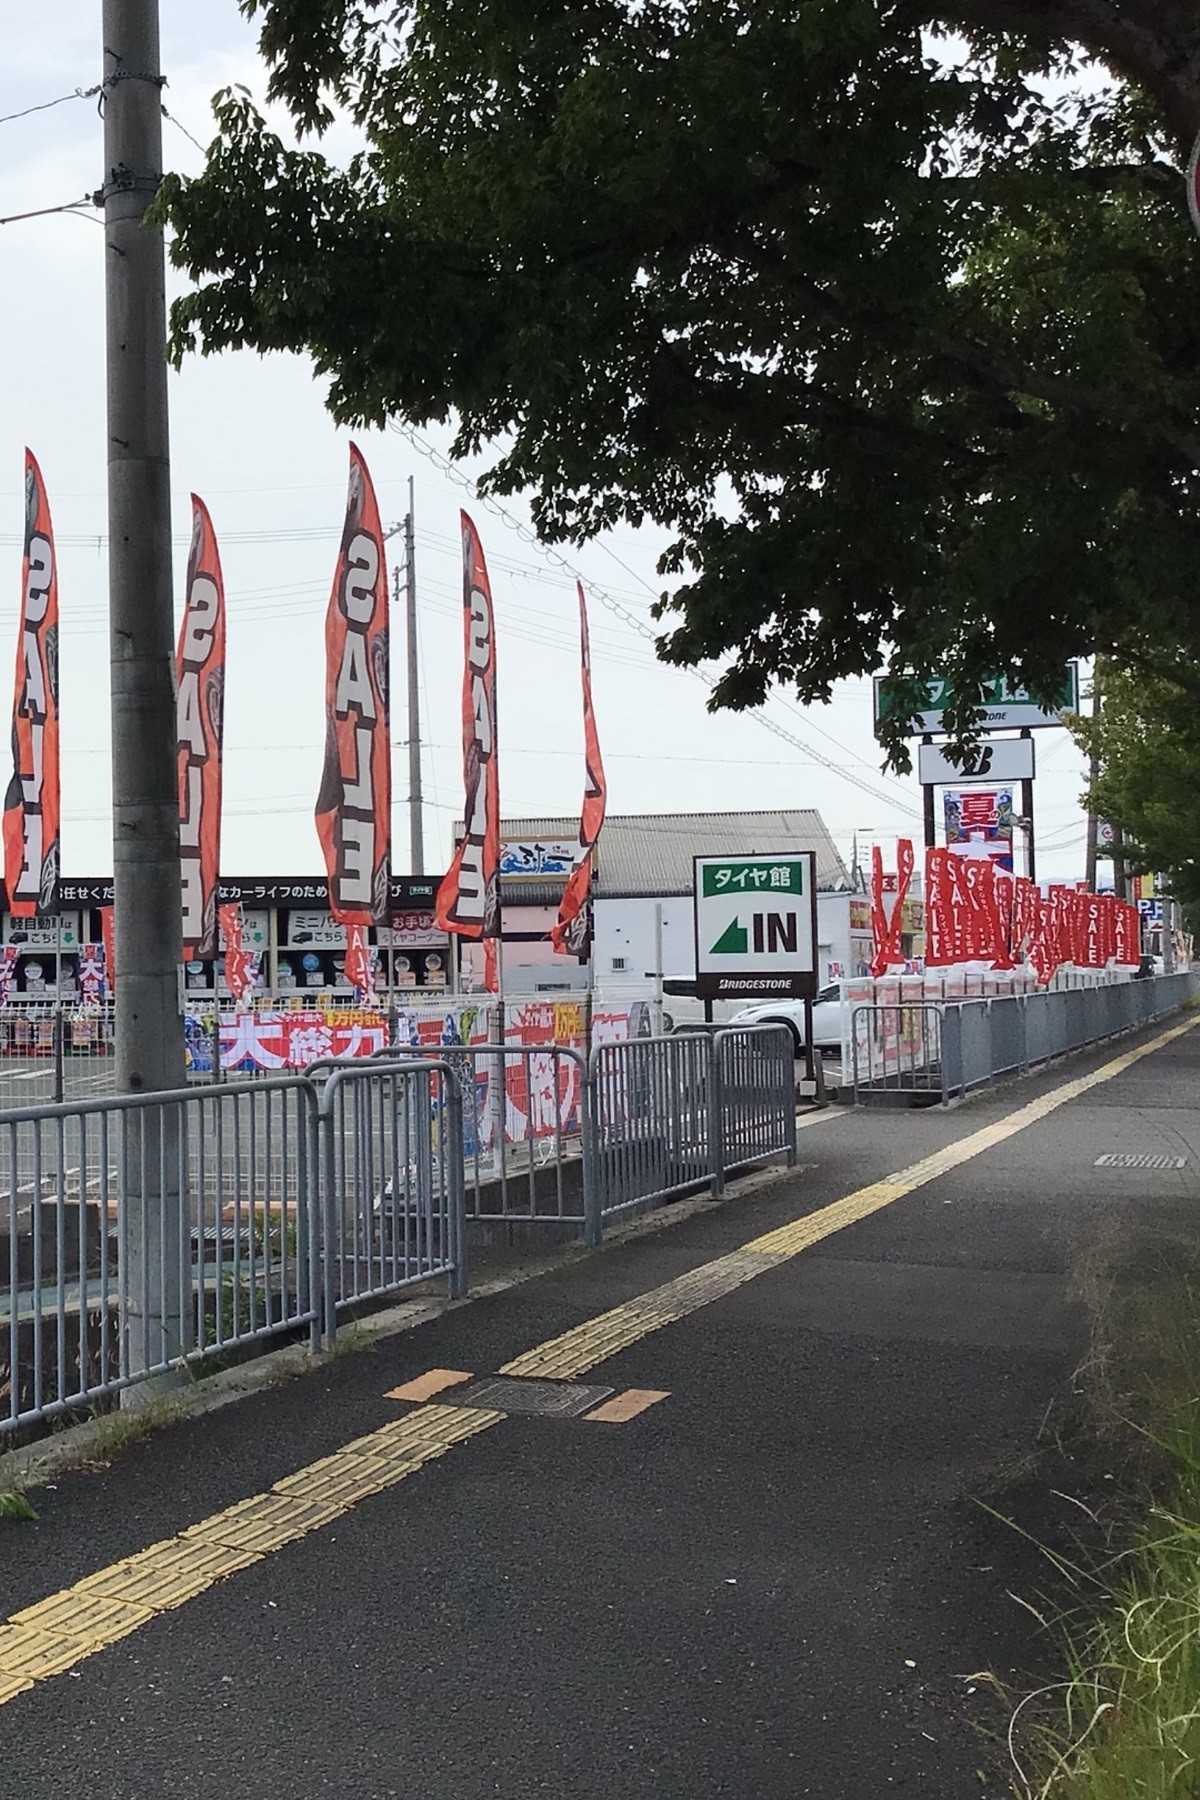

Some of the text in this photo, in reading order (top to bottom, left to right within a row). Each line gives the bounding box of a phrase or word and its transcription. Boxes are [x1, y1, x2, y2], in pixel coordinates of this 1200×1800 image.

[714, 865, 792, 889] タイヤ館
[59, 886, 115, 900] 任せくだ
[753, 912, 798, 954] IN
[1087, 904, 1098, 964] SALE
[718, 978, 793, 990] BRIDGESTONE
